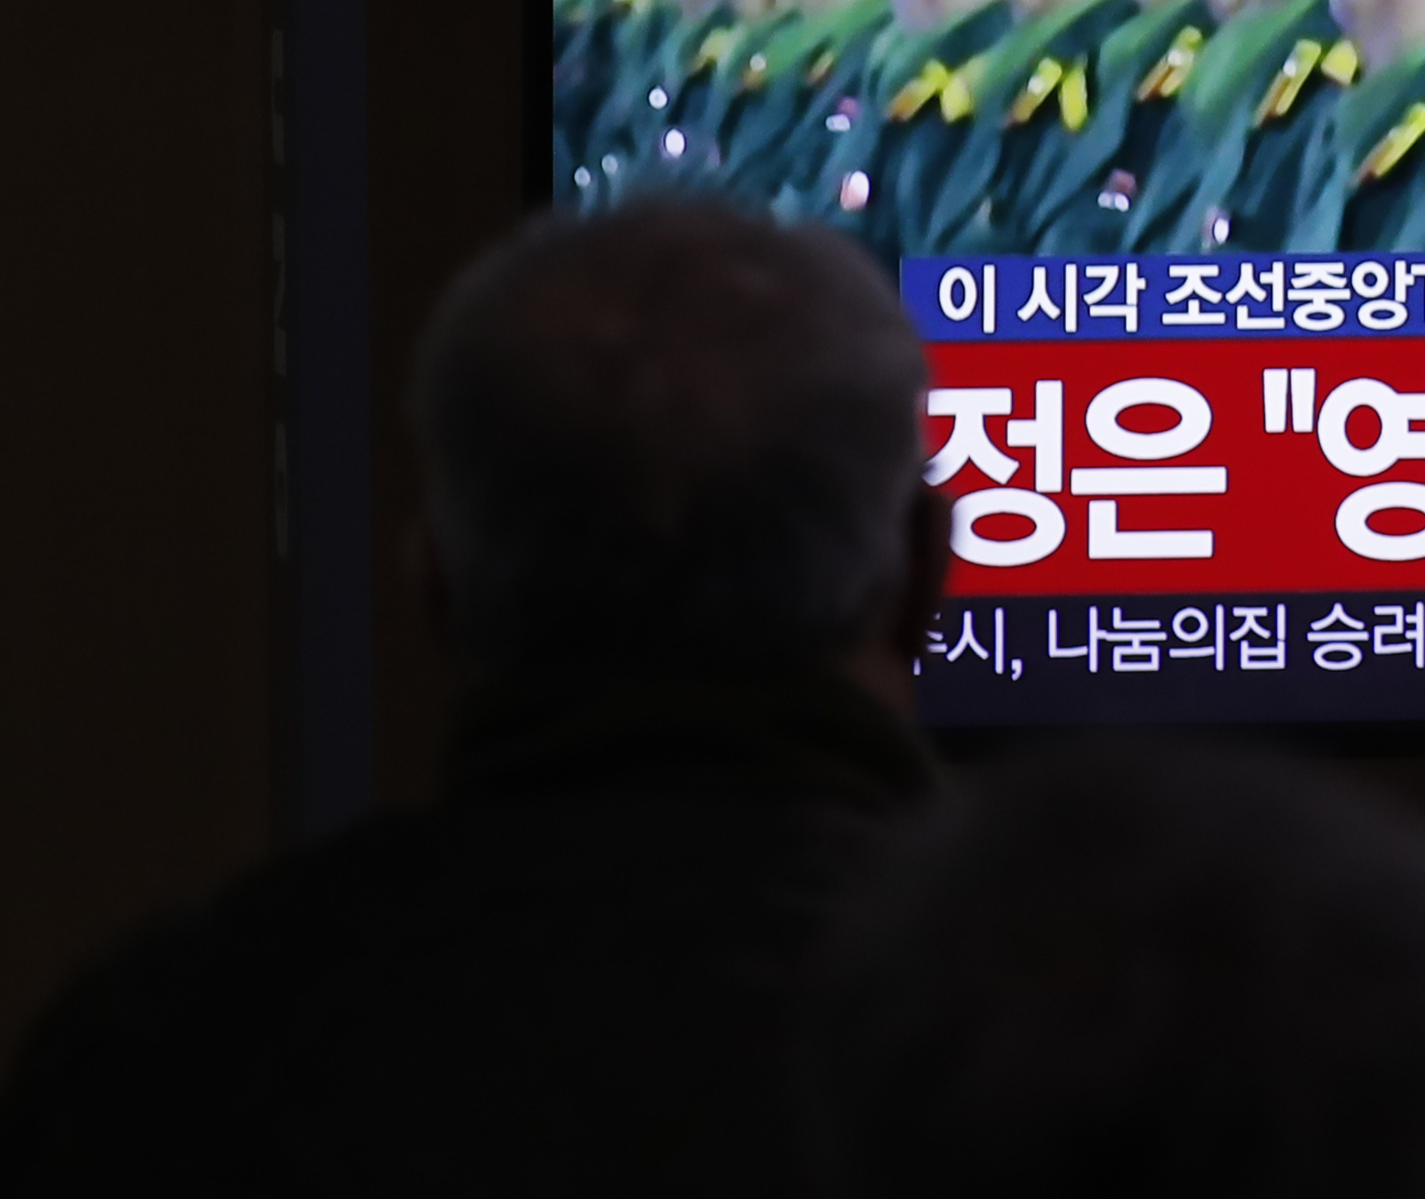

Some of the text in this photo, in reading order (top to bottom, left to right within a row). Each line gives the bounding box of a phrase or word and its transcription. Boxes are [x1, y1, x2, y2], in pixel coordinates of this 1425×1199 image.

[938, 264, 996, 334] 이
[1017, 263, 1147, 333] 시각
[921, 377, 1227, 568] 정은
[1048, 604, 1286, 674] 나눔의집
